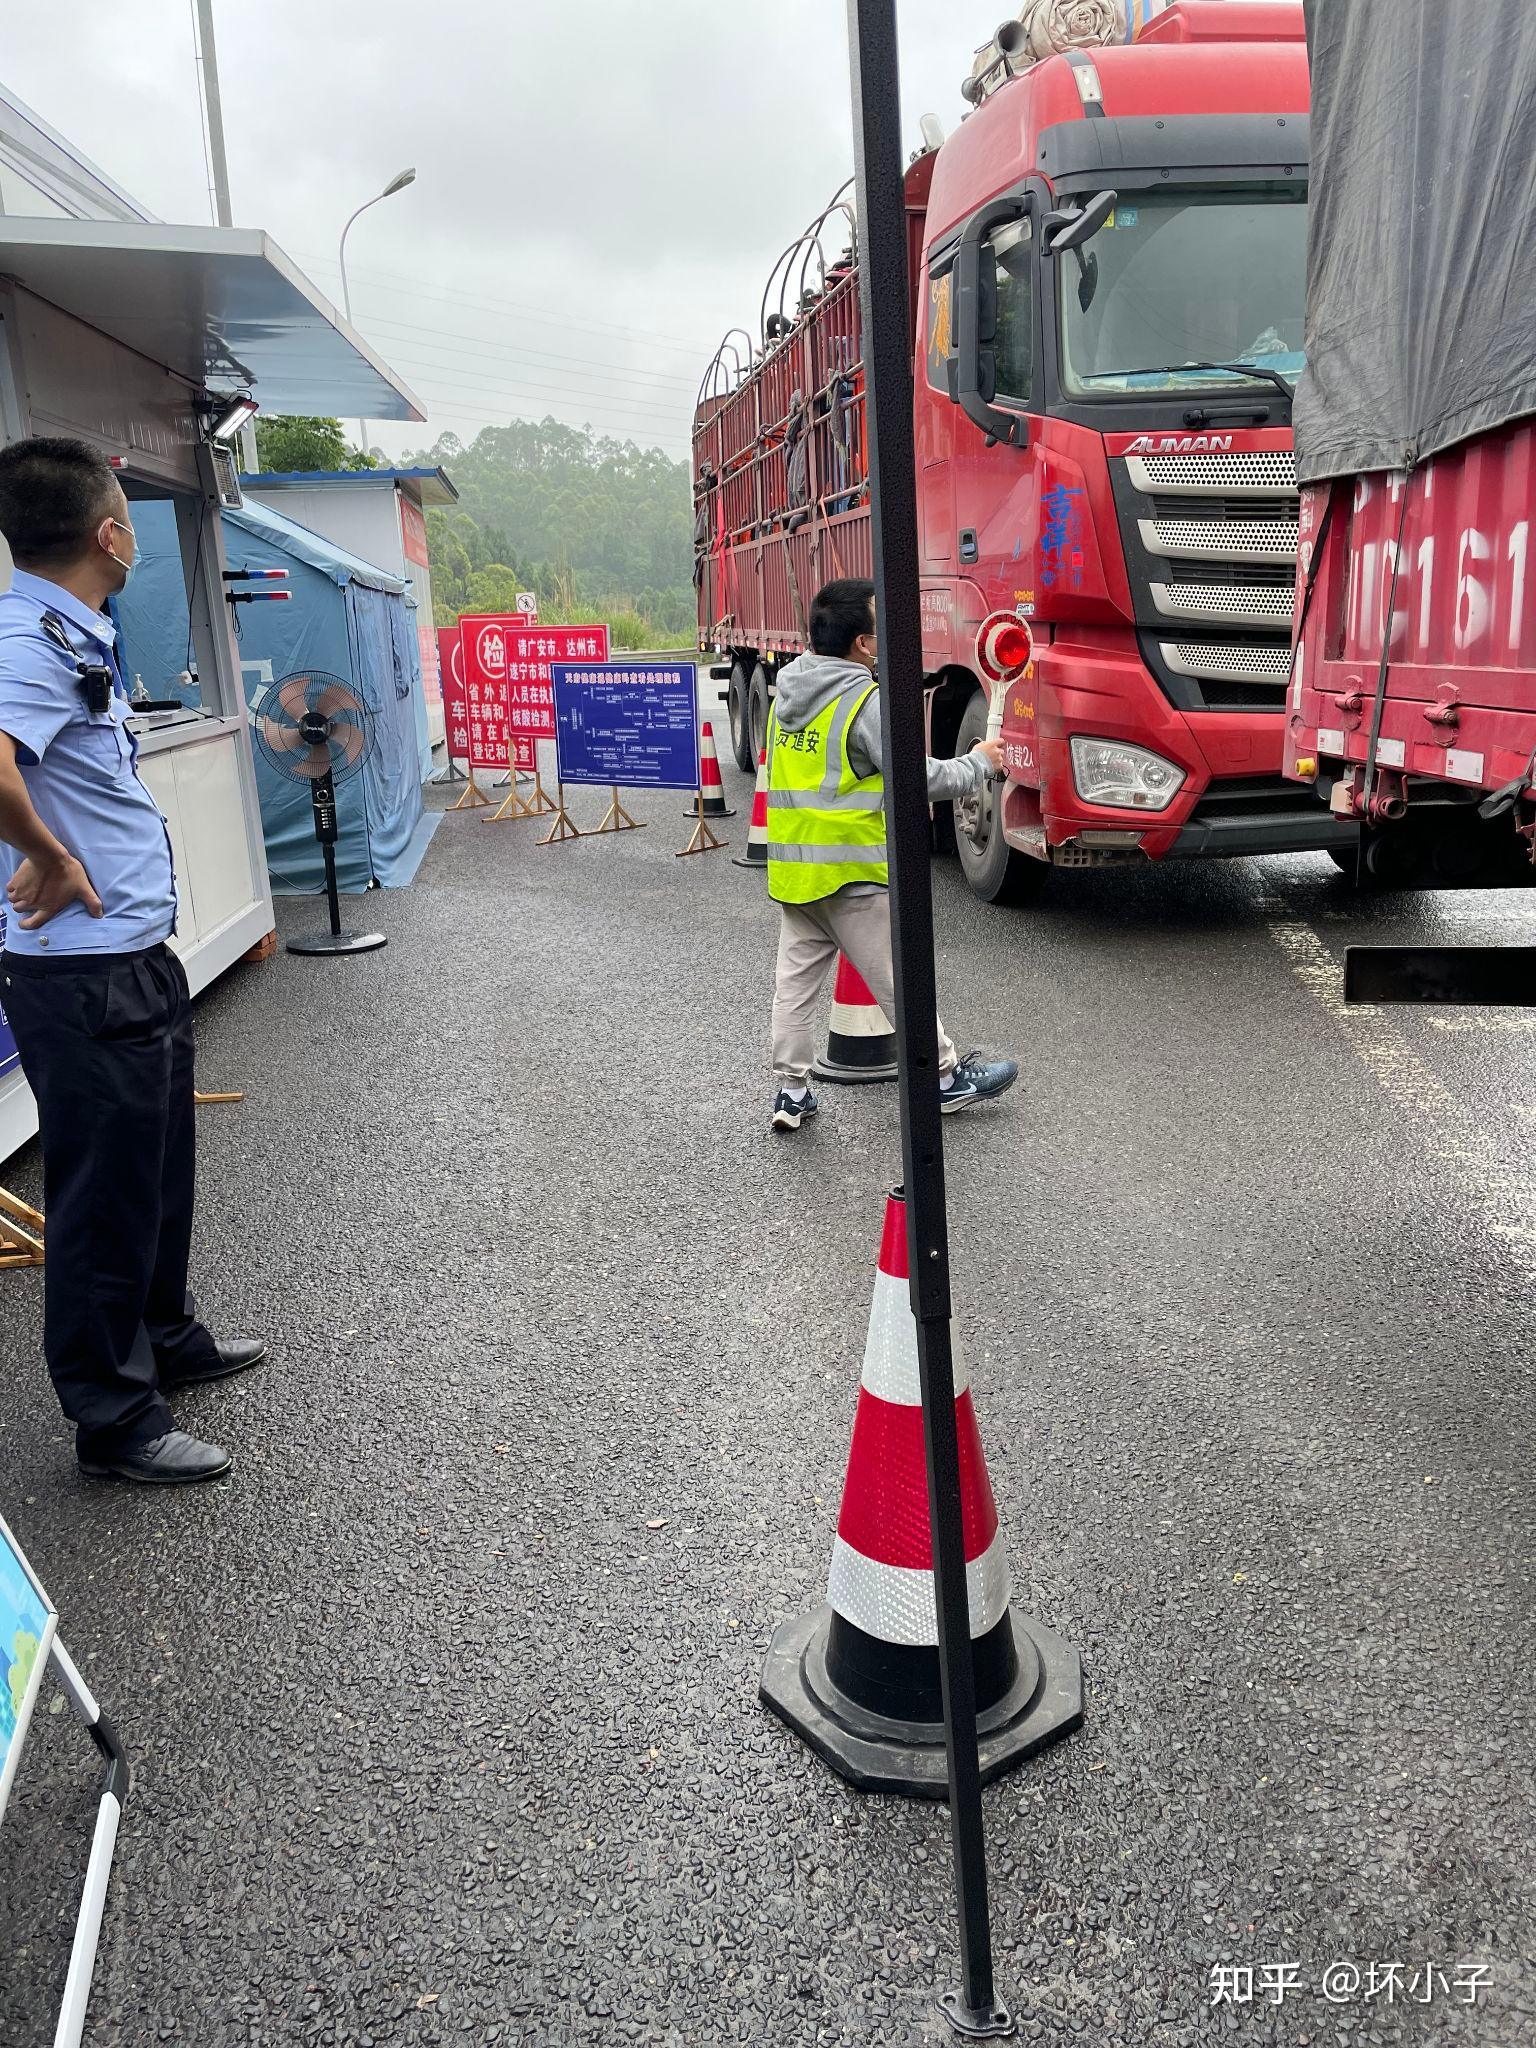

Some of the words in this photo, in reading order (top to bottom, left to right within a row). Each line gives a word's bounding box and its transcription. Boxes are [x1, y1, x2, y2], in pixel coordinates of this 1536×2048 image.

[1122, 435, 1232, 455] AUMAN
[483, 634, 505, 669] 检
[509, 662, 551, 681] 遂宁市和
[451, 700, 466, 722] 车
[470, 703, 508, 722] 车辆和
[512, 708, 555, 728] 核酸检测。
[453, 726, 467, 748] 检
[472, 723, 528, 743] 请在此
